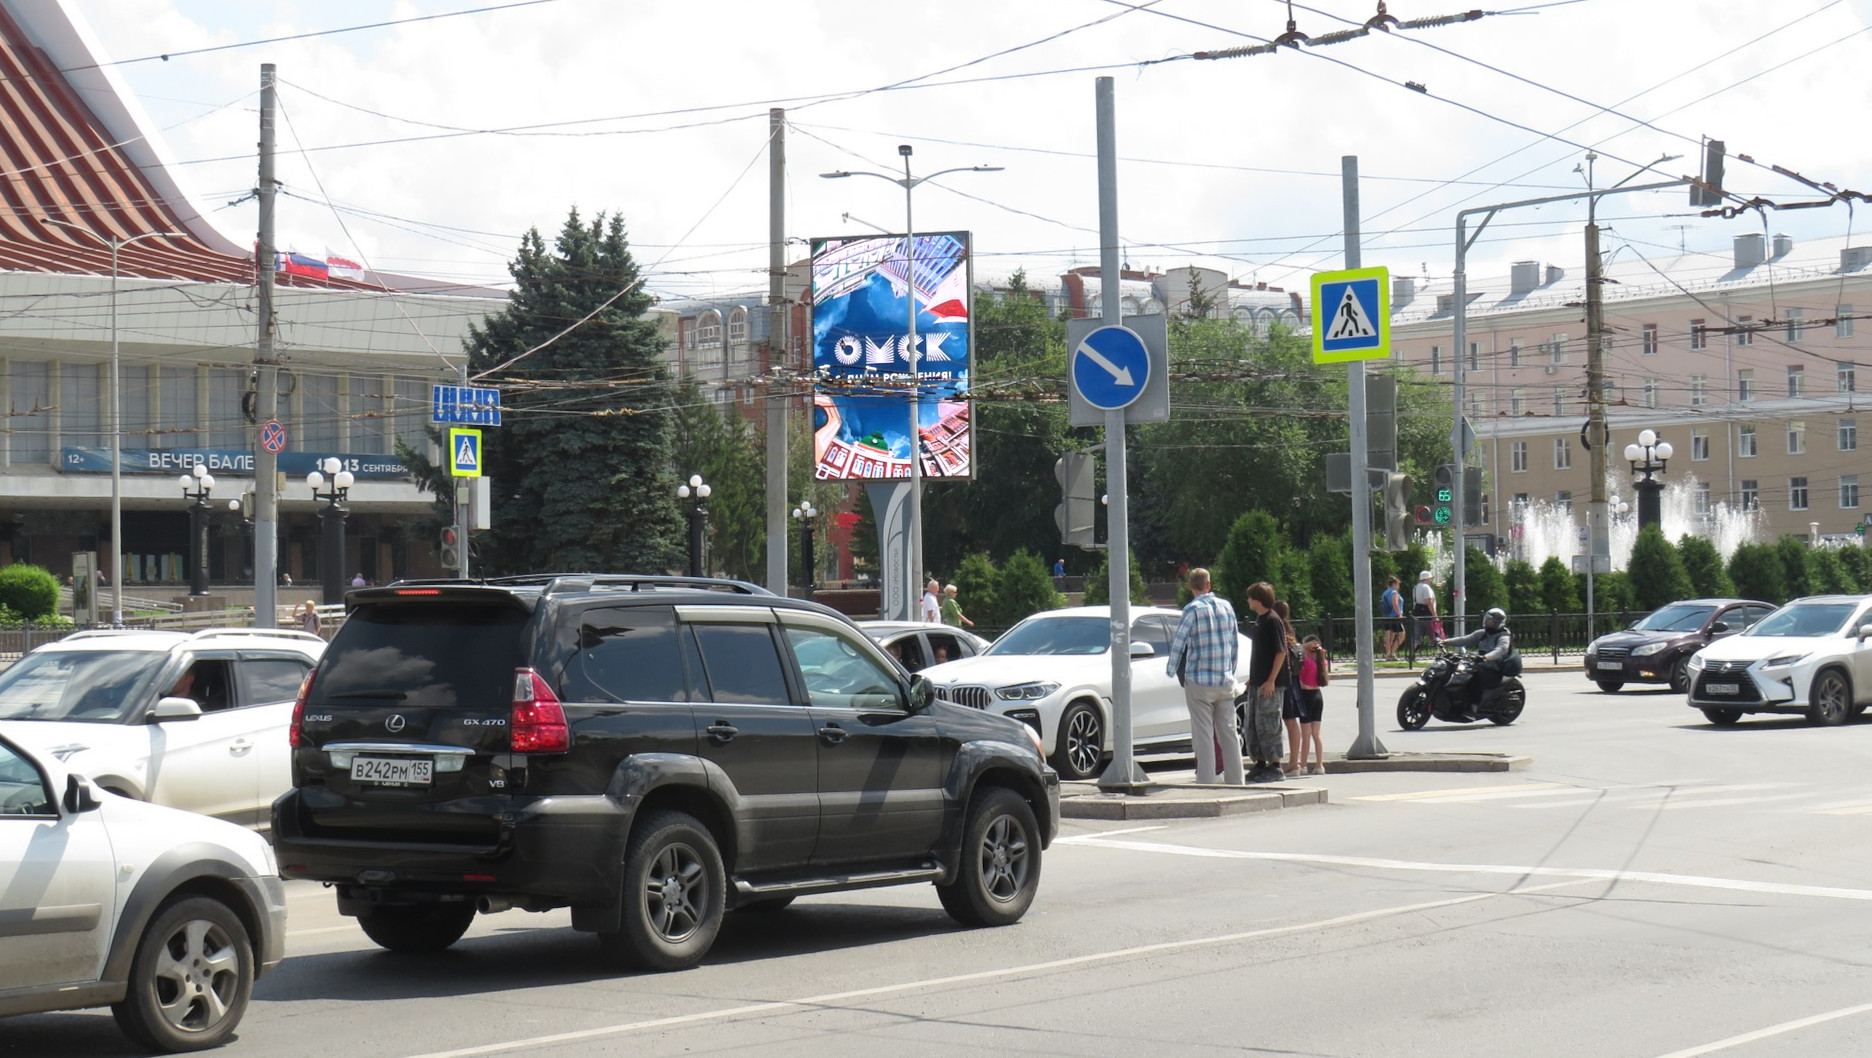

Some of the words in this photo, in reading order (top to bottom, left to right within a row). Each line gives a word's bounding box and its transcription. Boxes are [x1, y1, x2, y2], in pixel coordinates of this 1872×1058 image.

[834, 332, 951, 365] ОМСК
[68, 455, 85, 464] 12+
[150, 452, 205, 468] ВЕЧЕР
[209, 454, 255, 470] БАЛЕ
[305, 714, 332, 722] LEXUS
[411, 762, 429, 776] 155
[489, 780, 505, 788] V8
